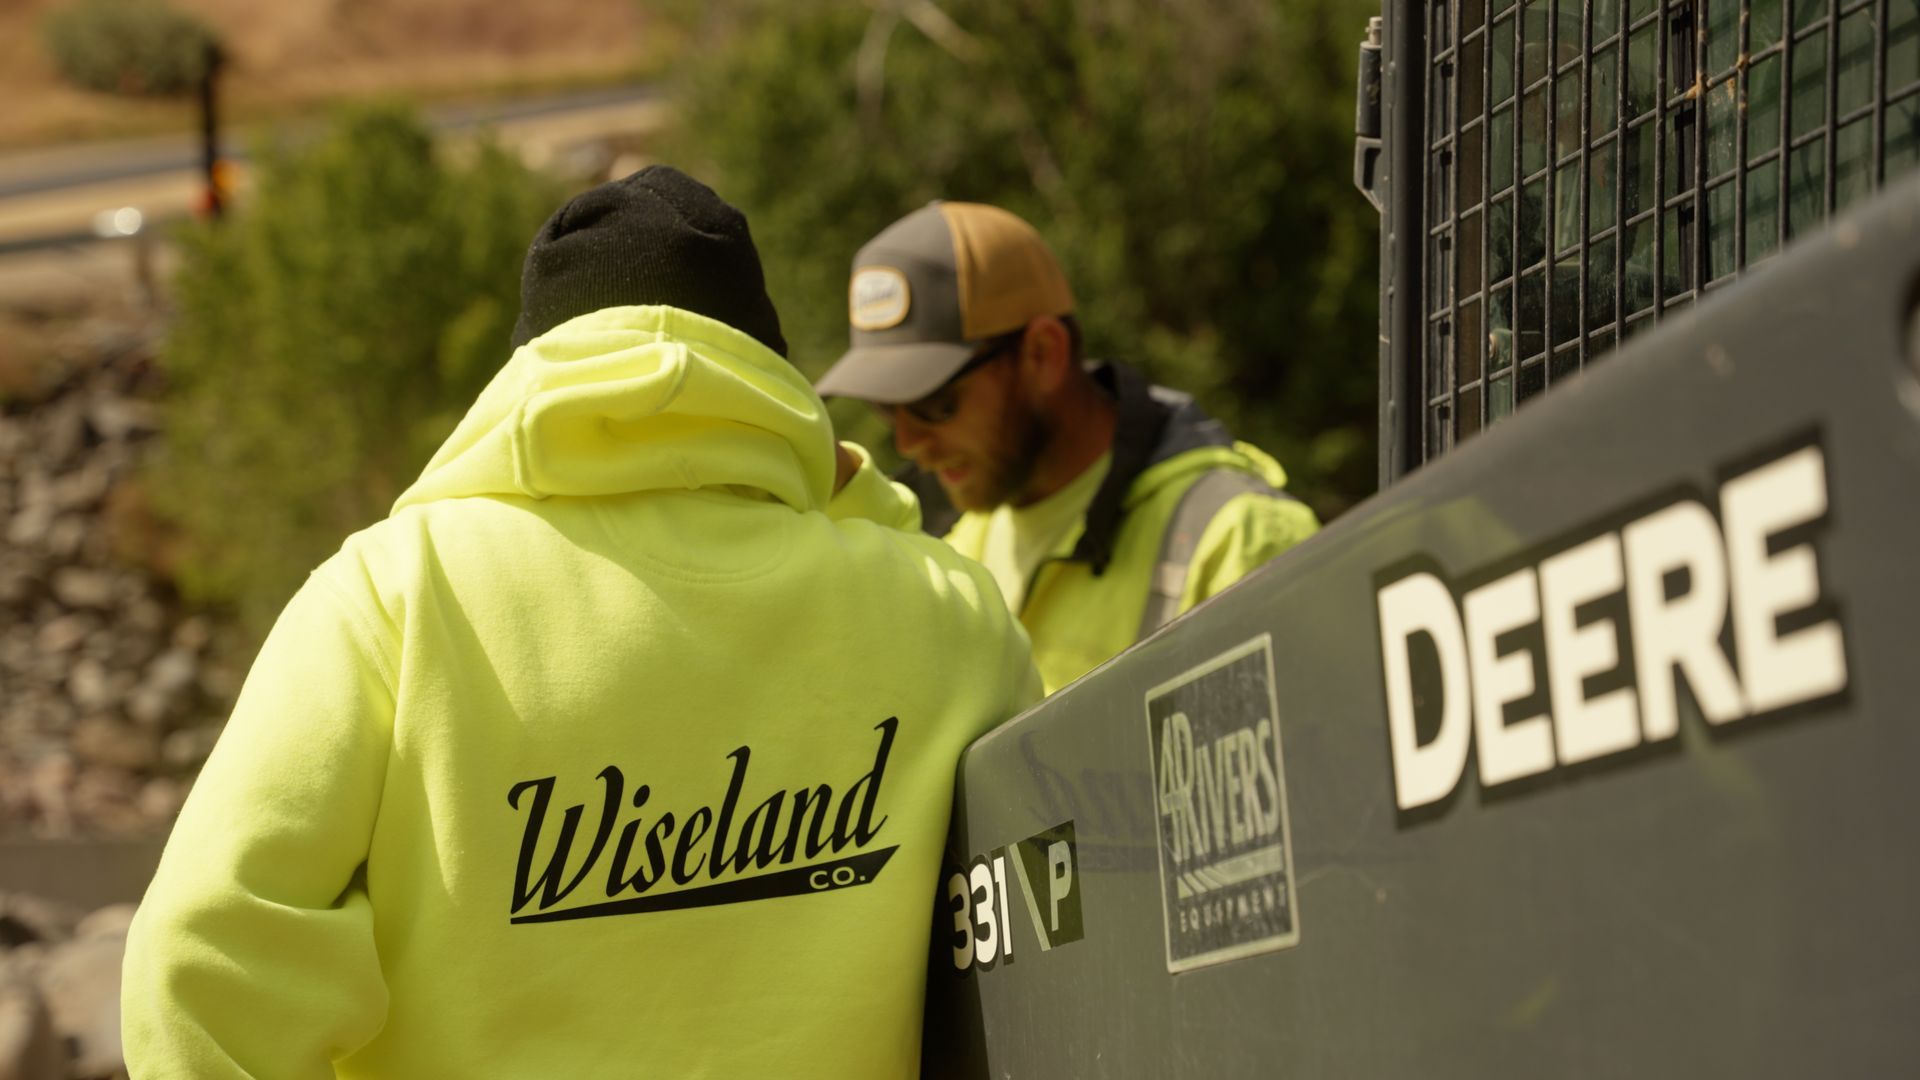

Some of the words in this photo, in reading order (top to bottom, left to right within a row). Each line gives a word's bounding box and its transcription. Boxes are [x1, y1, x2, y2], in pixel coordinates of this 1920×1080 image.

[1377, 445, 1848, 810] DEERE
[507, 716, 899, 915] Wiseland
[809, 866, 867, 890] CO.
[948, 855, 1013, 970] 331
[1048, 839, 1073, 932] P
[1180, 881, 1287, 934] EQUIPMENT
